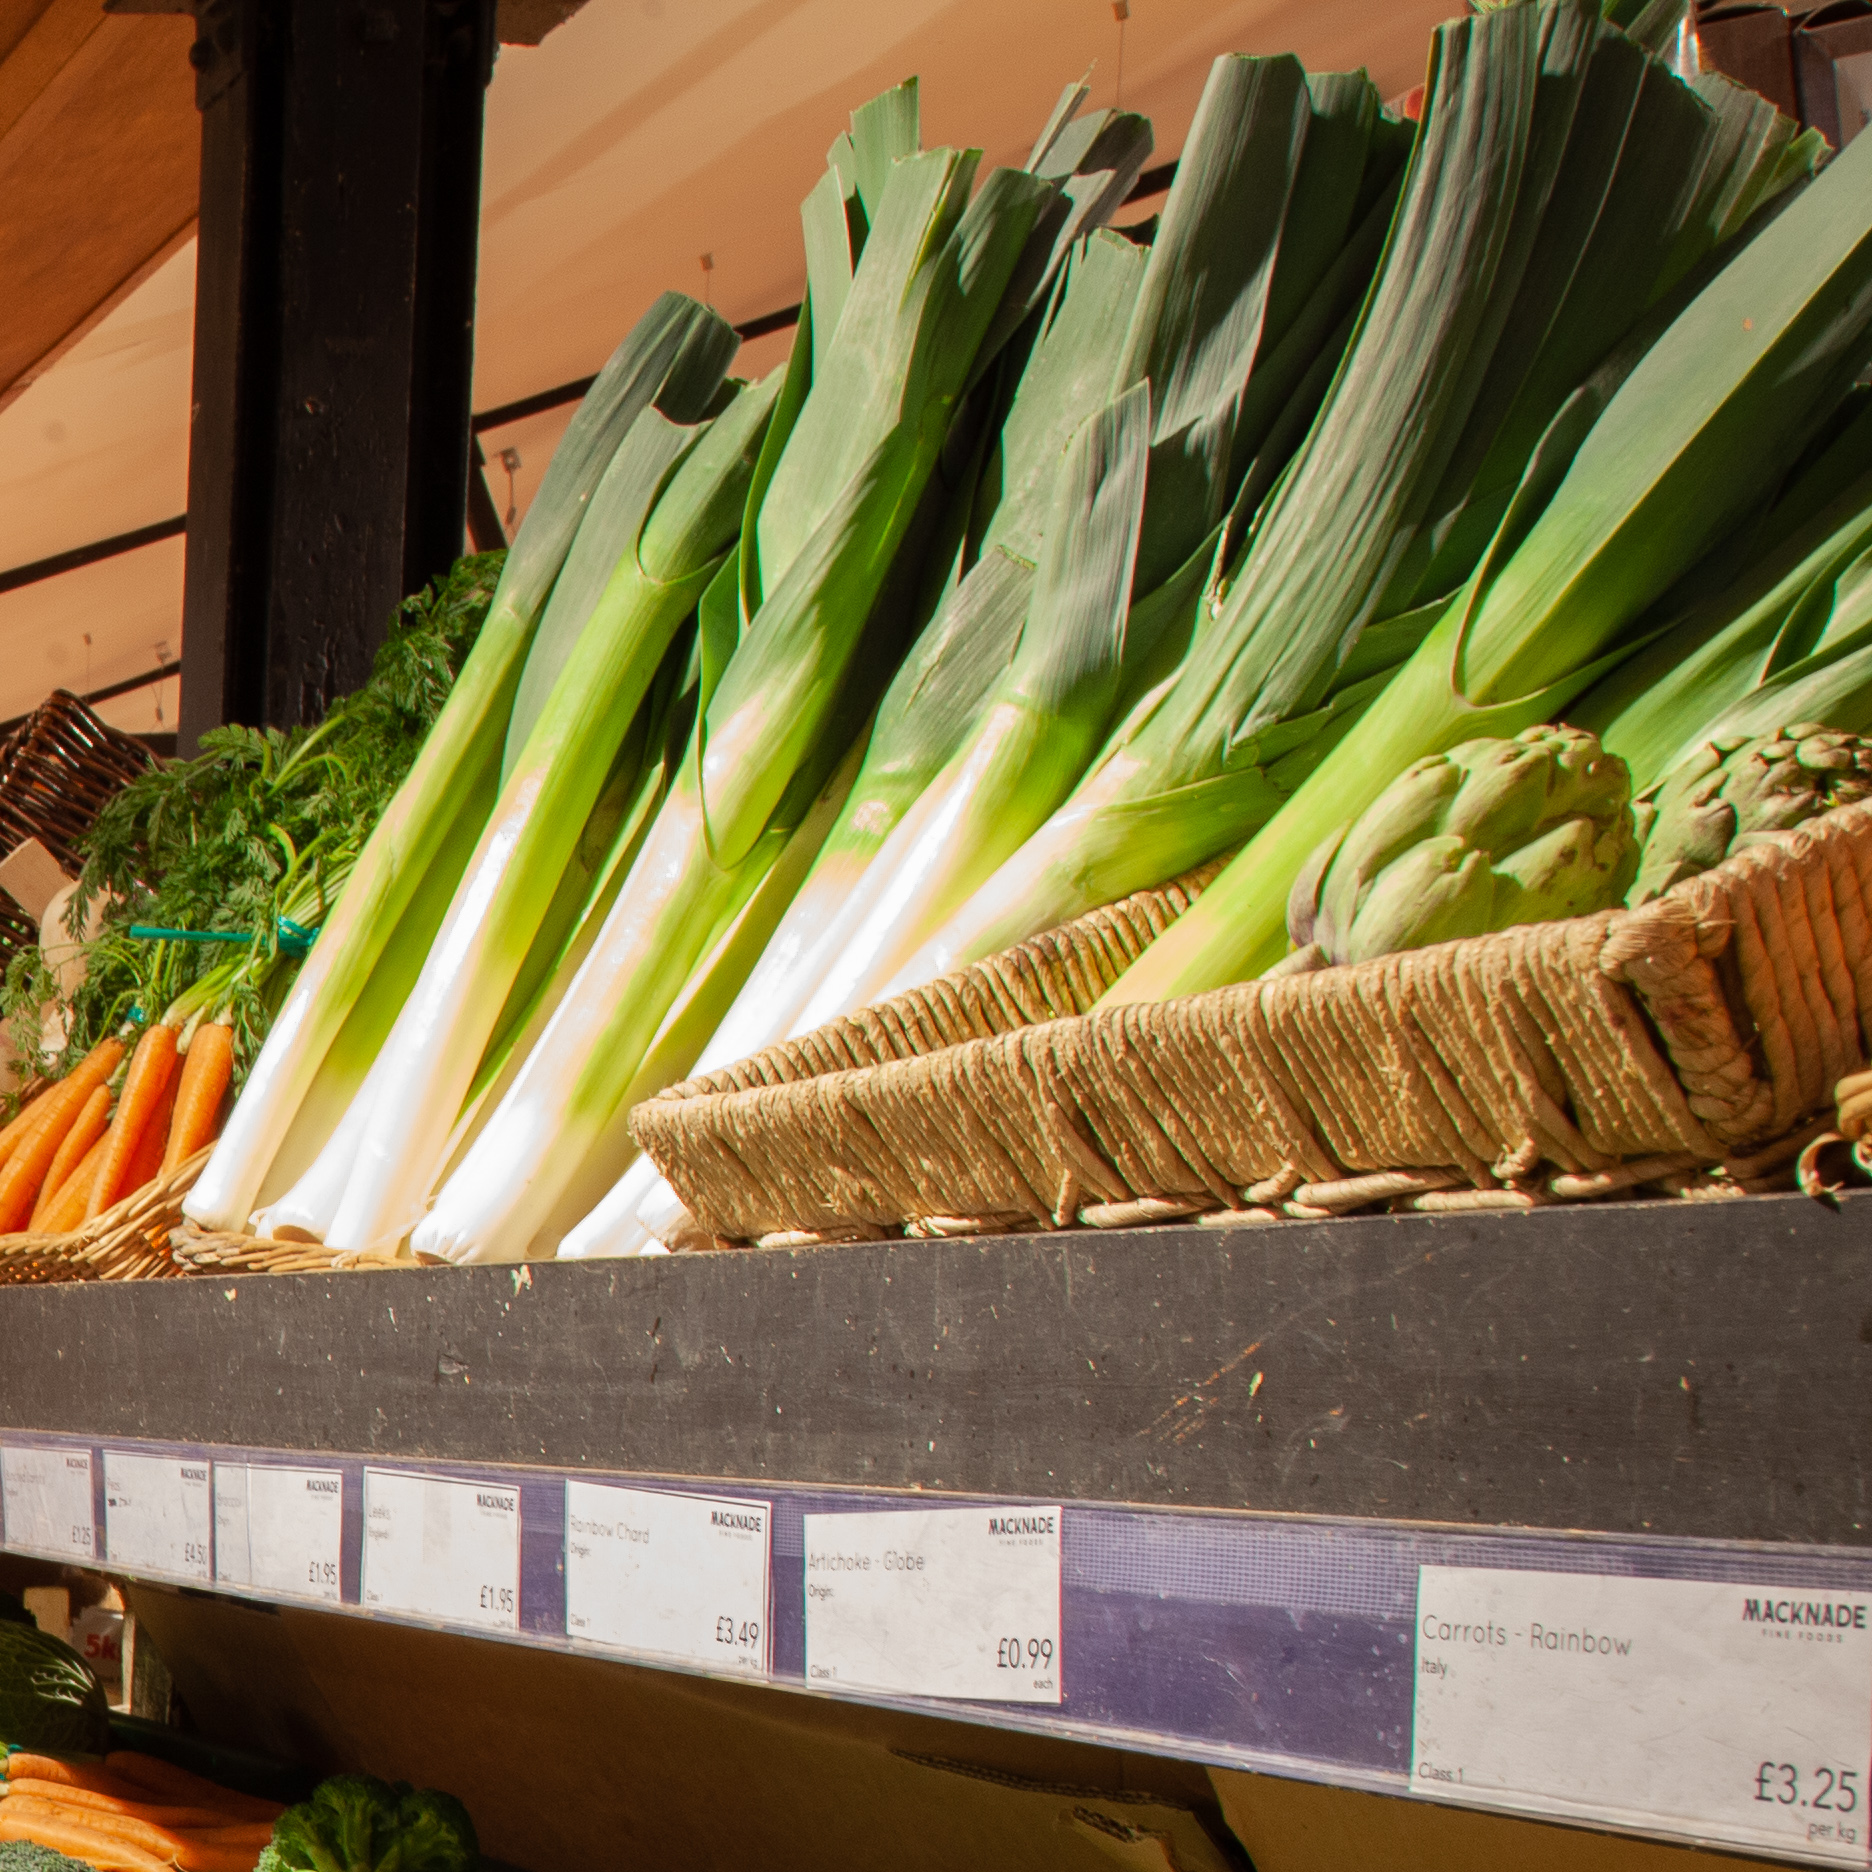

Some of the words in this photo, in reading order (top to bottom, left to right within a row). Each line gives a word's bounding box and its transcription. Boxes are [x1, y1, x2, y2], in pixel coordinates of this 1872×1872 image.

[476, 1493, 515, 1512] MACKNADE
[570, 1514, 613, 1538] Rainbow
[616, 1521, 650, 1545] Chard
[710, 1510, 762, 1533] MACKNADE
[988, 1516, 1054, 1536] MACKNADE
[808, 1550, 871, 1572] Artichoke
[882, 1550, 926, 1572] Globe
[308, 1560, 336, 1586] £1.95
[480, 1584, 514, 1614] £1.95
[1742, 1598, 1868, 1630] MACKNADE
[715, 1615, 759, 1649] £3.49
[1421, 1614, 1507, 1646] Carrots
[1530, 1622, 1633, 1657] Rainbow
[1762, 1628, 1791, 1641] FINE
[1799, 1631, 1844, 1644] FOODS
[996, 1637, 1053, 1670] £0.99
[1420, 1657, 1448, 1680] Italy
[1033, 1678, 1053, 1690] each
[1418, 1762, 1452, 1782] Class
[1753, 1760, 1859, 1813] £3.25
[1808, 1823, 1833, 1843] per
[1836, 1822, 1857, 1844] kg
